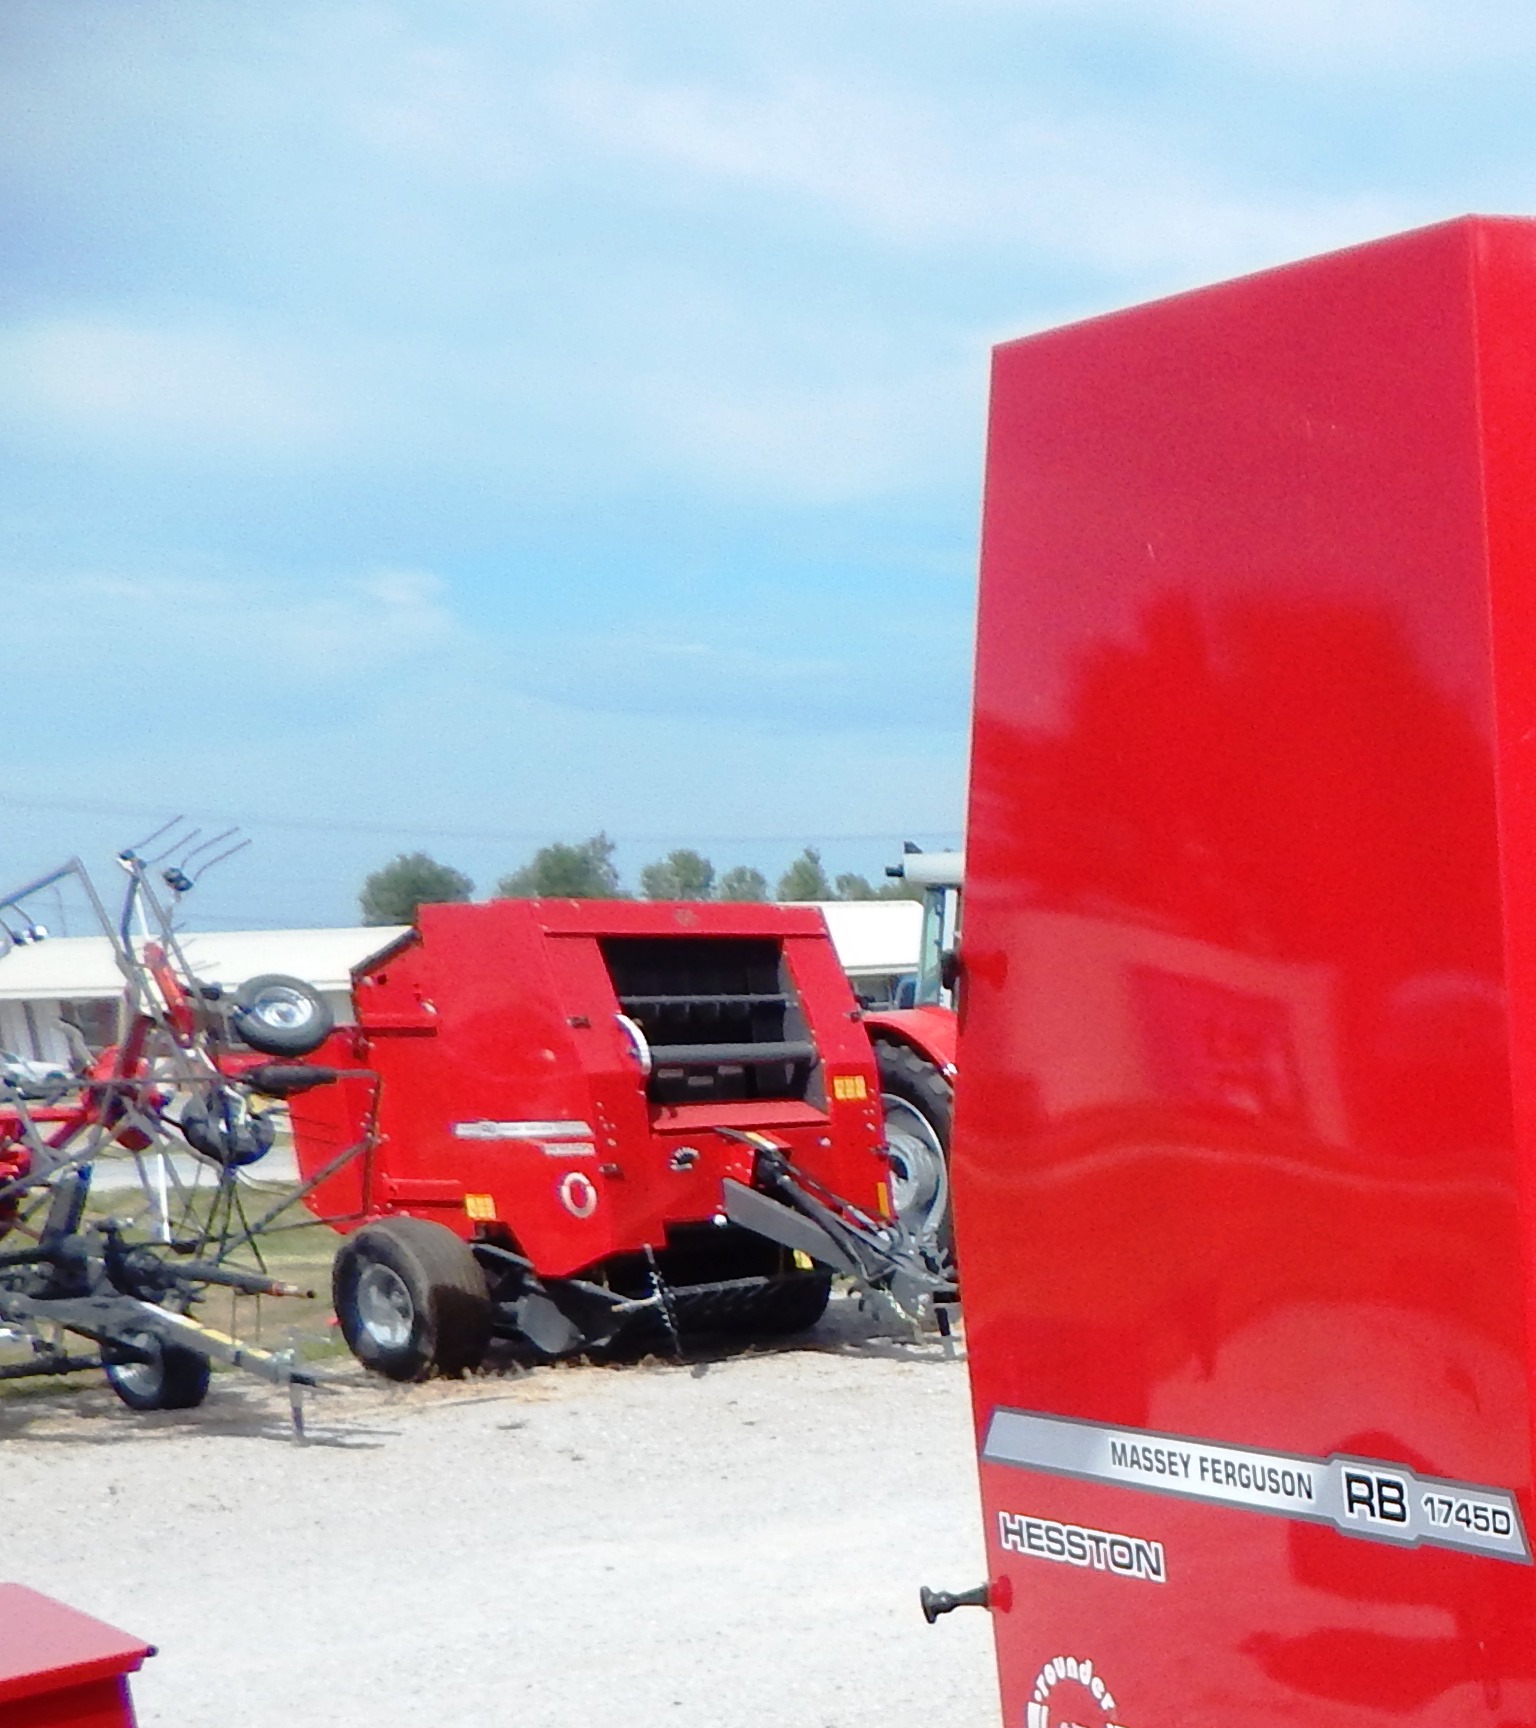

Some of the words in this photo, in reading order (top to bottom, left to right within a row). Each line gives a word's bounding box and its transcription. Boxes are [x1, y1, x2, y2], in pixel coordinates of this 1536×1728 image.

[1111, 1441, 1191, 1478] MASSEY
[1199, 1456, 1312, 1500] FERGUSON
[1344, 1470, 1406, 1523] RB
[1424, 1496, 1511, 1535] 1745D
[1000, 1513, 1164, 1580] HESSTON
